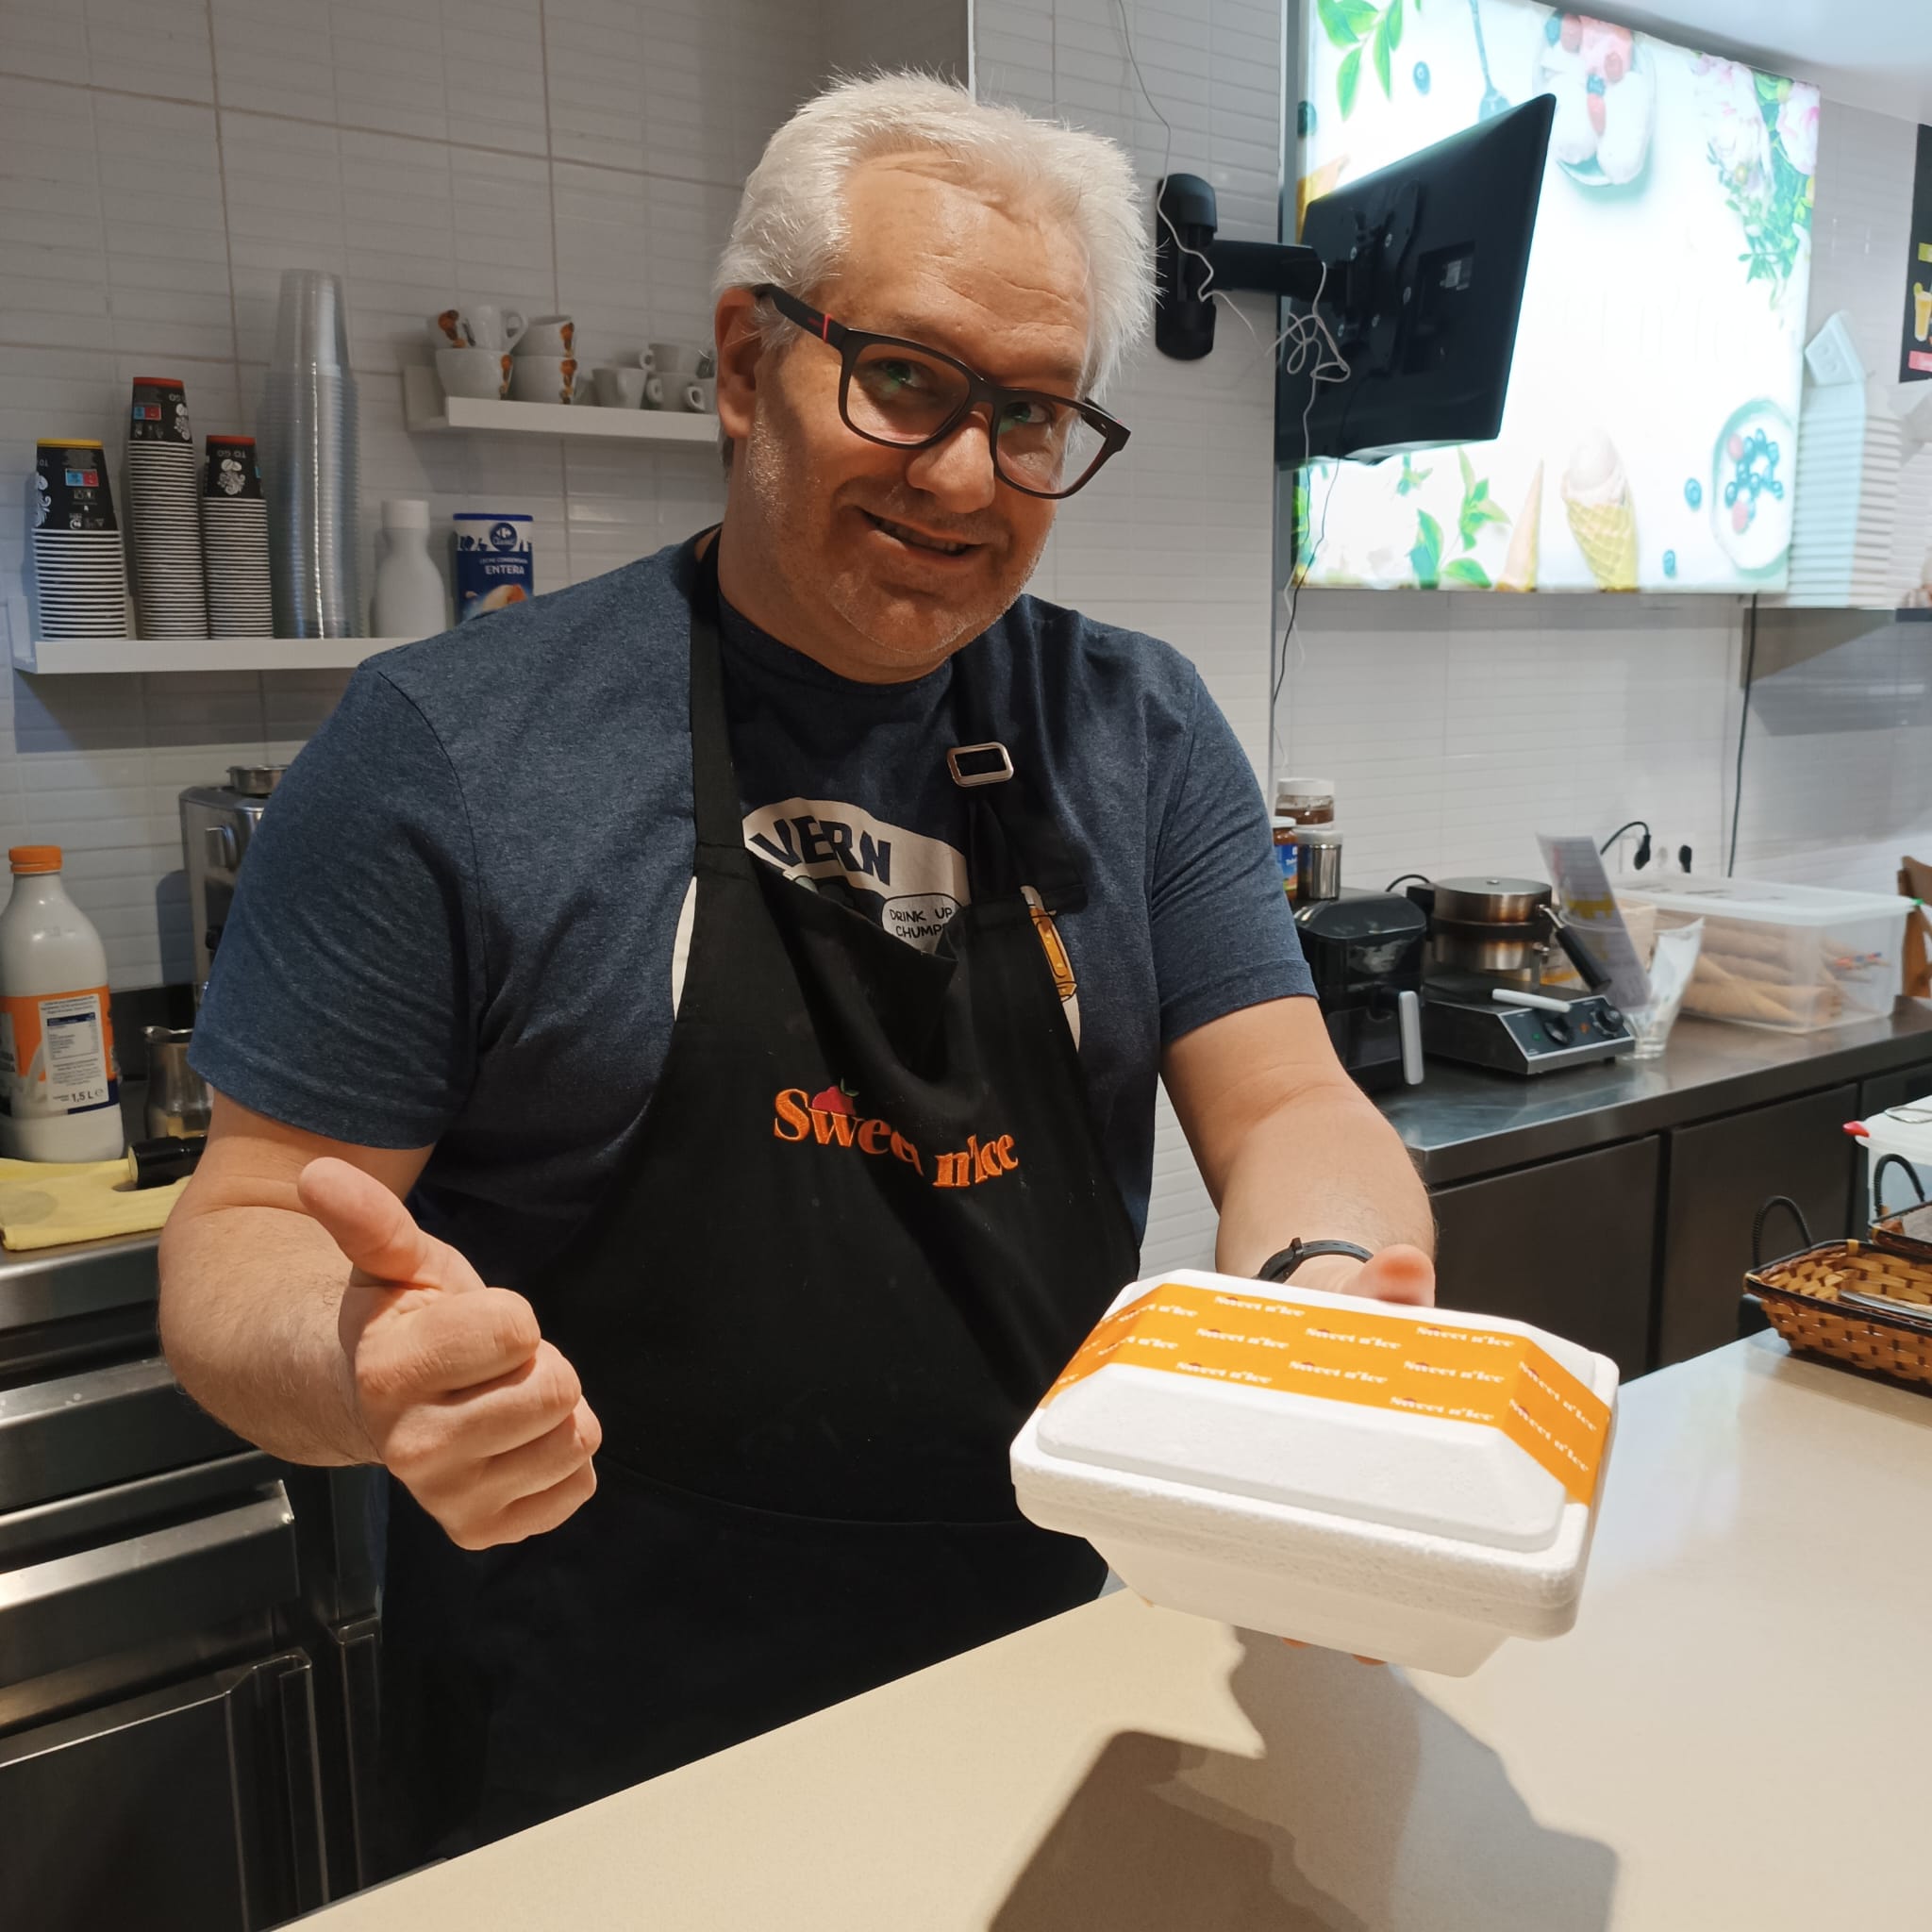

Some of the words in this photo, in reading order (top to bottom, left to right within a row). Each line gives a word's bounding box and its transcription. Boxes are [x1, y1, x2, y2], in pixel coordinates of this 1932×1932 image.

[484, 565, 525, 575] ENTERA
[889, 908, 926, 924] DRINK
[934, 907, 953, 920] UP
[71, 1091, 87, 1103] 1,5
[87, 1091, 94, 1100] L
